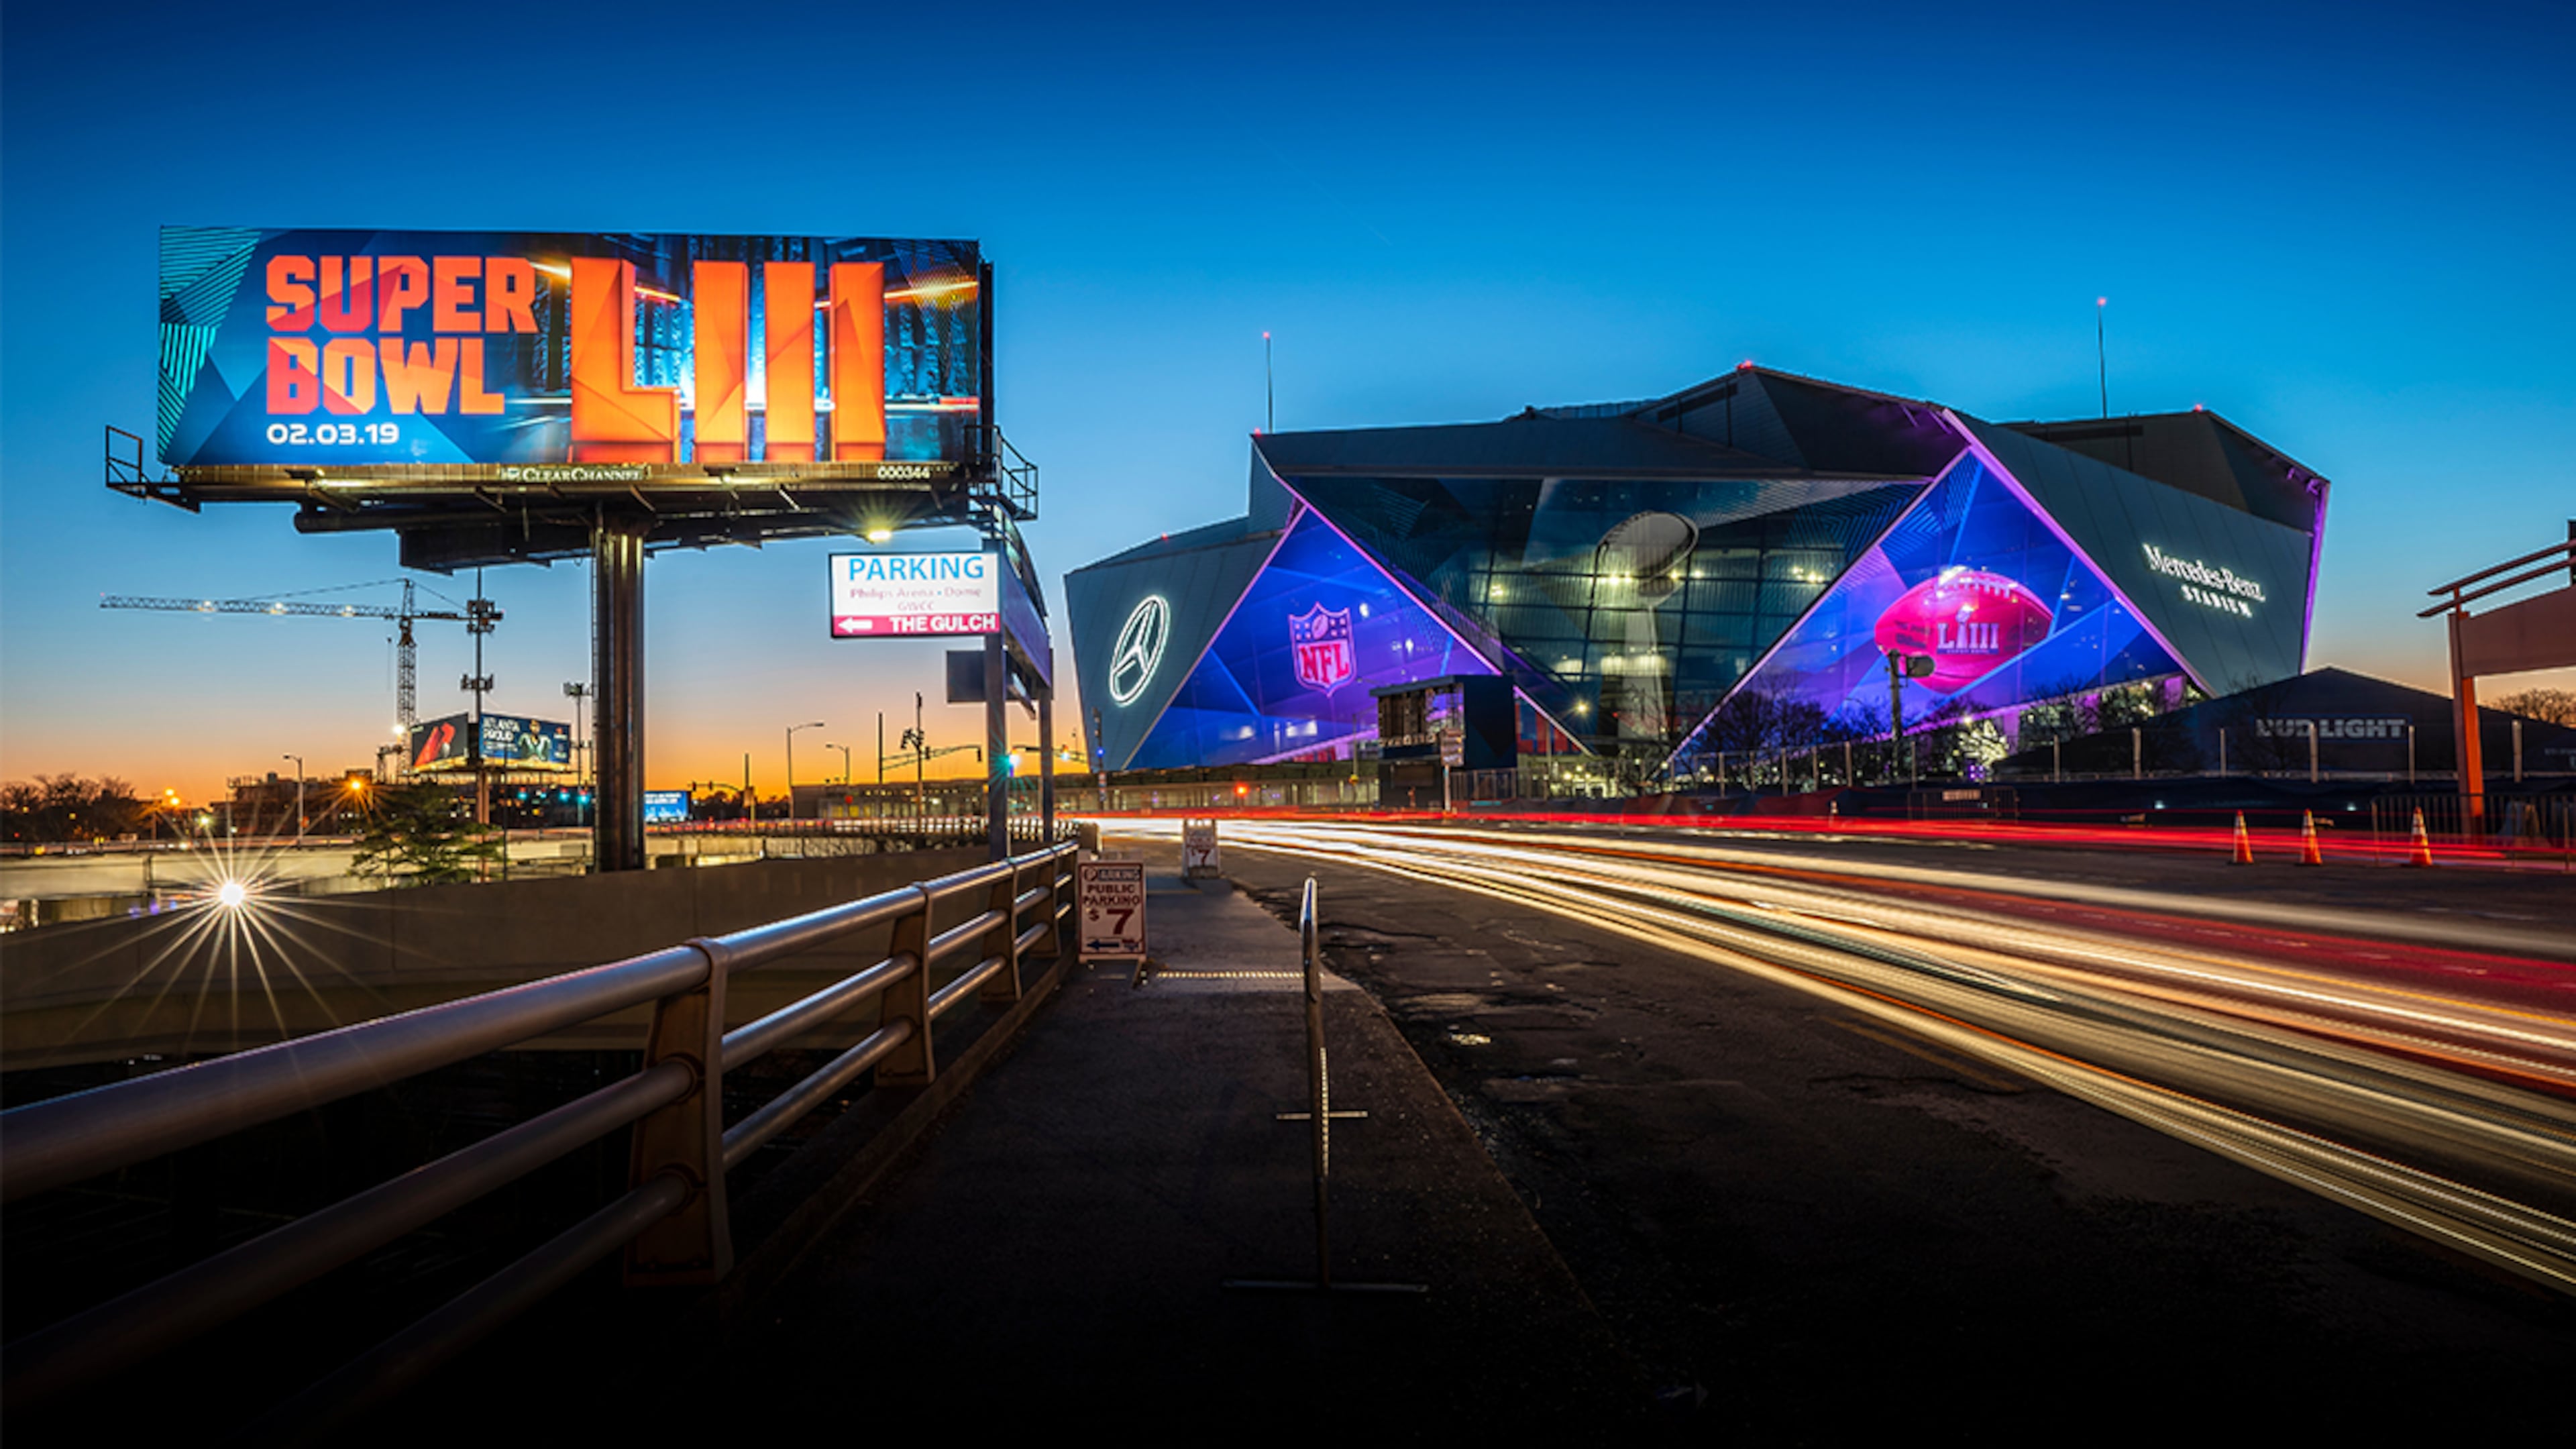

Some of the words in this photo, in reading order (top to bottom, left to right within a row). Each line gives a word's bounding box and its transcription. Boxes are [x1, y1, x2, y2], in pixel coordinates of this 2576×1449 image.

[266, 255, 537, 333] SUPER
[570, 257, 886, 464] LIII
[266, 337, 504, 415] BOWL
[266, 423, 399, 445] 02.03.19
[877, 466, 930, 480] 000344
[849, 555, 984, 581] PARKING
[2143, 543, 2265, 602] Mercedes-Benz
[2182, 584, 2252, 618] STADIUM
[889, 616, 927, 633] THE
[930, 614, 996, 631] GULCH
[1299, 643, 1350, 685] NFL
[2319, 719, 2406, 737] LIGHT
[1087, 884, 1135, 894] PUBLIC
